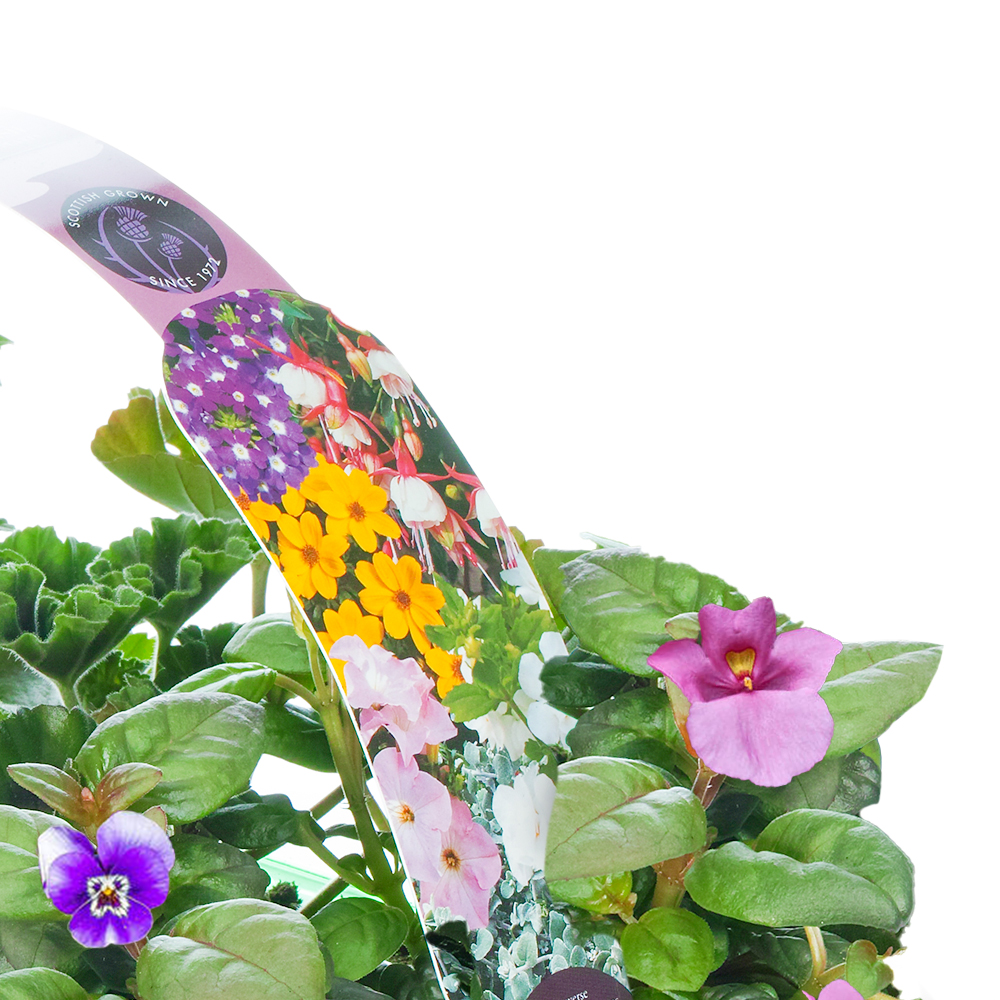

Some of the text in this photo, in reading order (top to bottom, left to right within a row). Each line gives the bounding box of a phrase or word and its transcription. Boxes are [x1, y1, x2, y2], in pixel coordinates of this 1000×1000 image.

[67, 189, 169, 228] SCOTTISH GROWN
[149, 257, 222, 288] SINCE 1972
